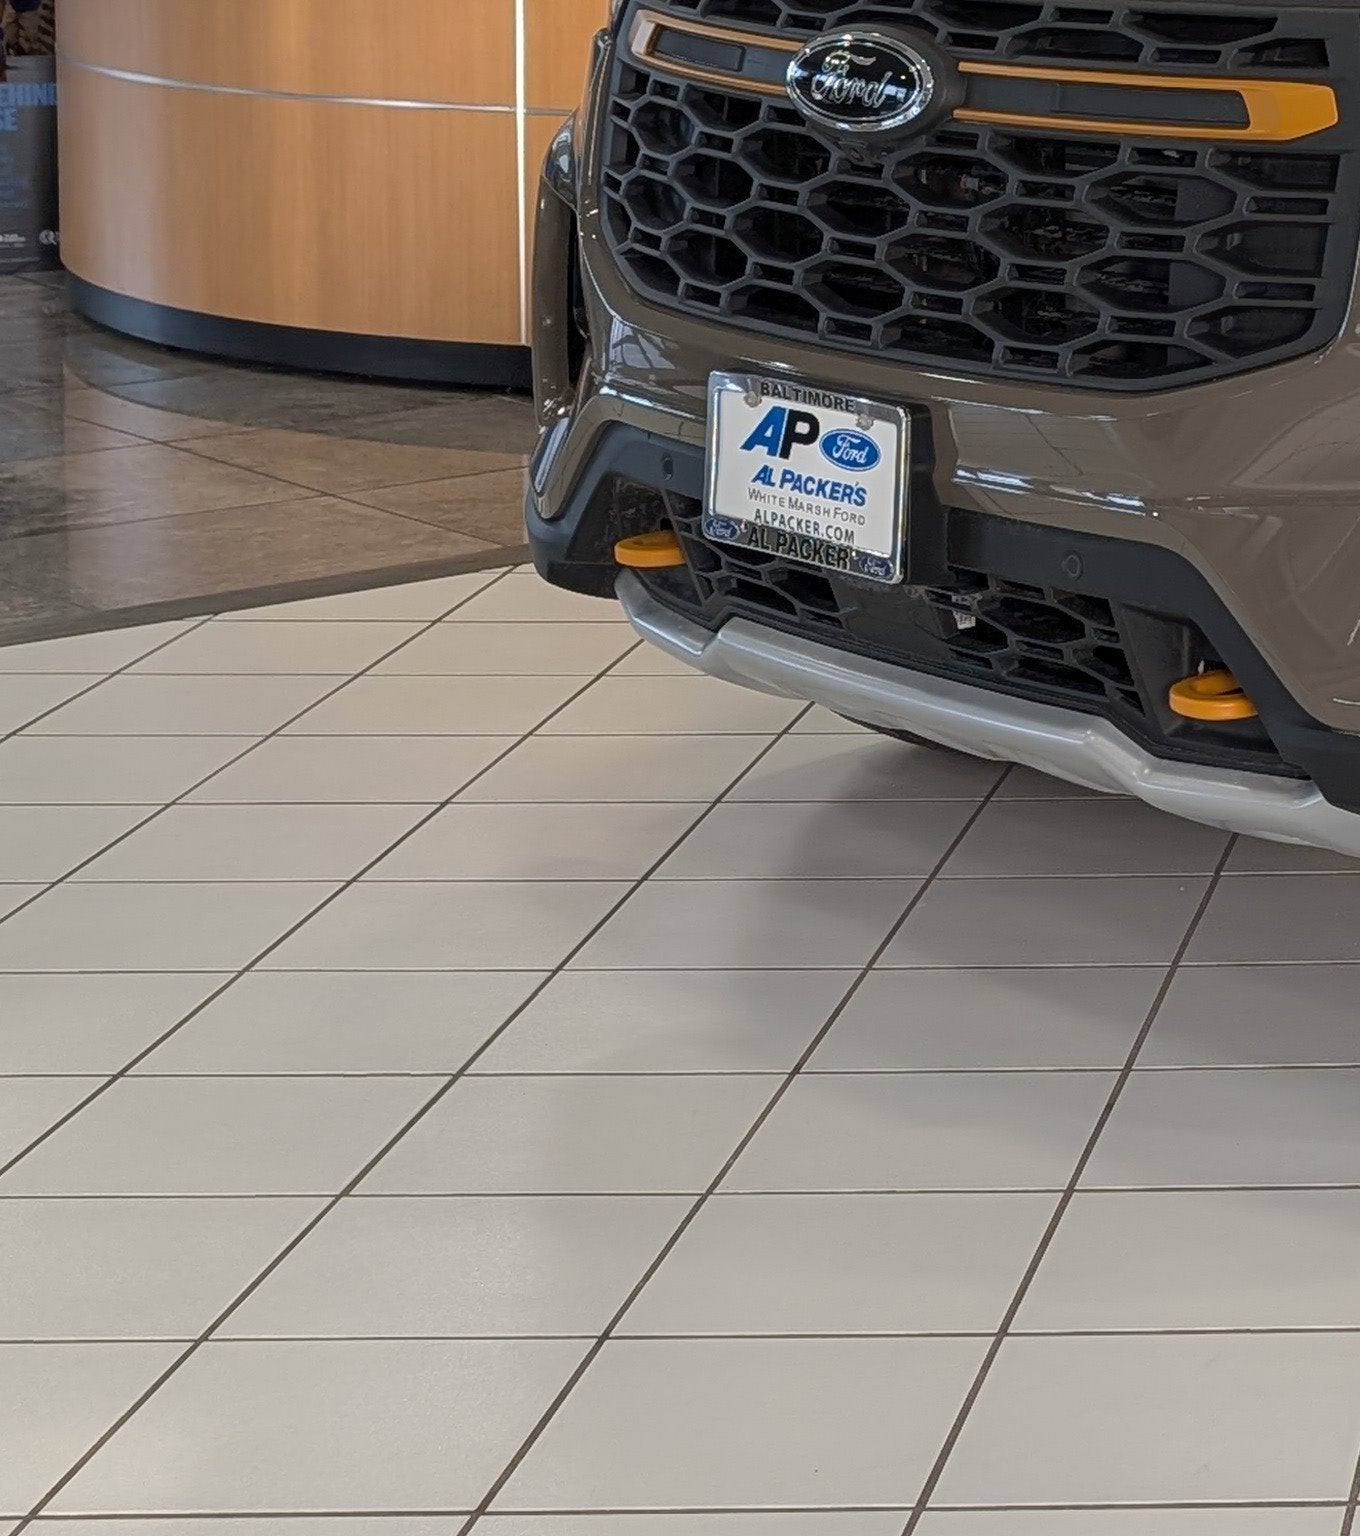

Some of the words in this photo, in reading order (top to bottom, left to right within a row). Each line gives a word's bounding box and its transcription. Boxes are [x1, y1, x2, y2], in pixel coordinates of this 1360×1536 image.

[810, 49, 893, 109] Ford
[759, 381, 855, 413] BALTIMORE
[739, 405, 821, 461] AP
[831, 433, 868, 464] Ford
[751, 464, 776, 487] AL
[779, 468, 868, 507] PACKER'S
[753, 507, 855, 545] ALPACKER.COM
[747, 525, 772, 550] AL
[775, 529, 851, 571] PACKER
